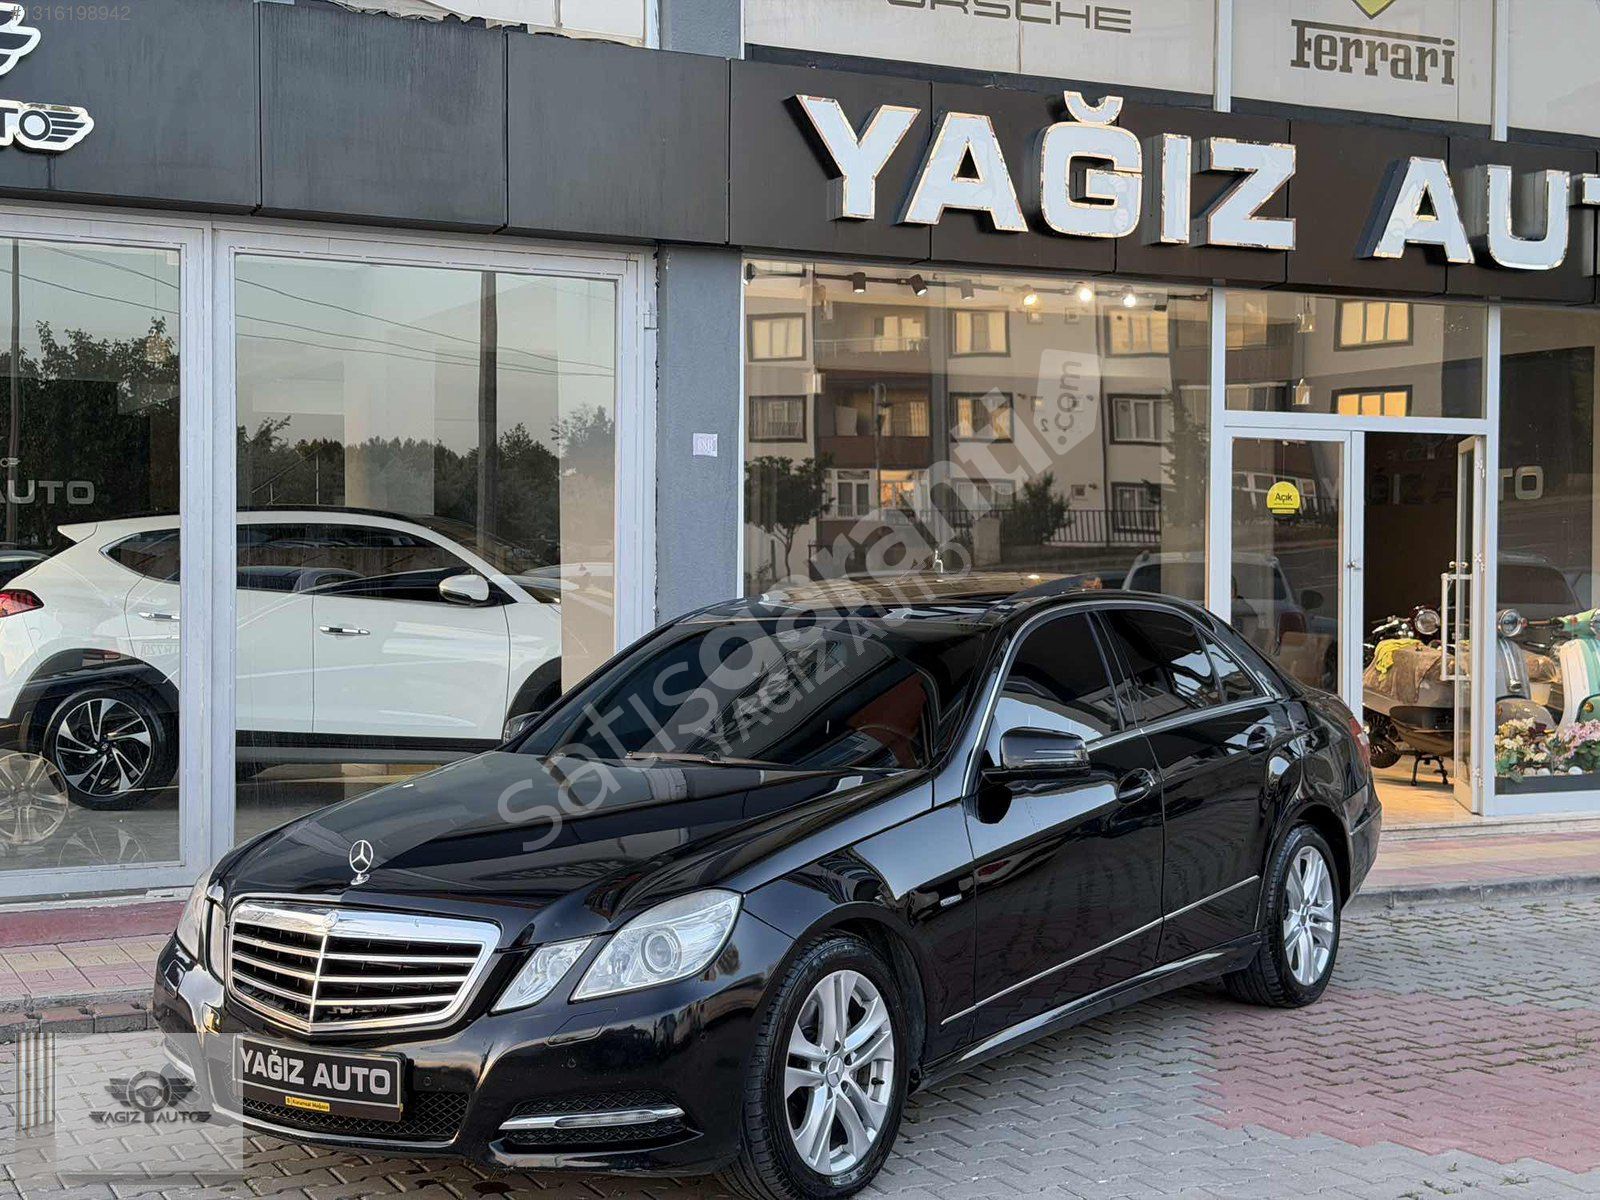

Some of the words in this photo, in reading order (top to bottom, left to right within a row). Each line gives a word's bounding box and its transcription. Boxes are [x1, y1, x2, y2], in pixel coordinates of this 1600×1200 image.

[1290, 19, 1455, 85] Ferrari
[796, 90, 1297, 251] YAĞIZ
[239, 1047, 305, 1086] YAĞIZ
[312, 1062, 391, 1096] AUTO
